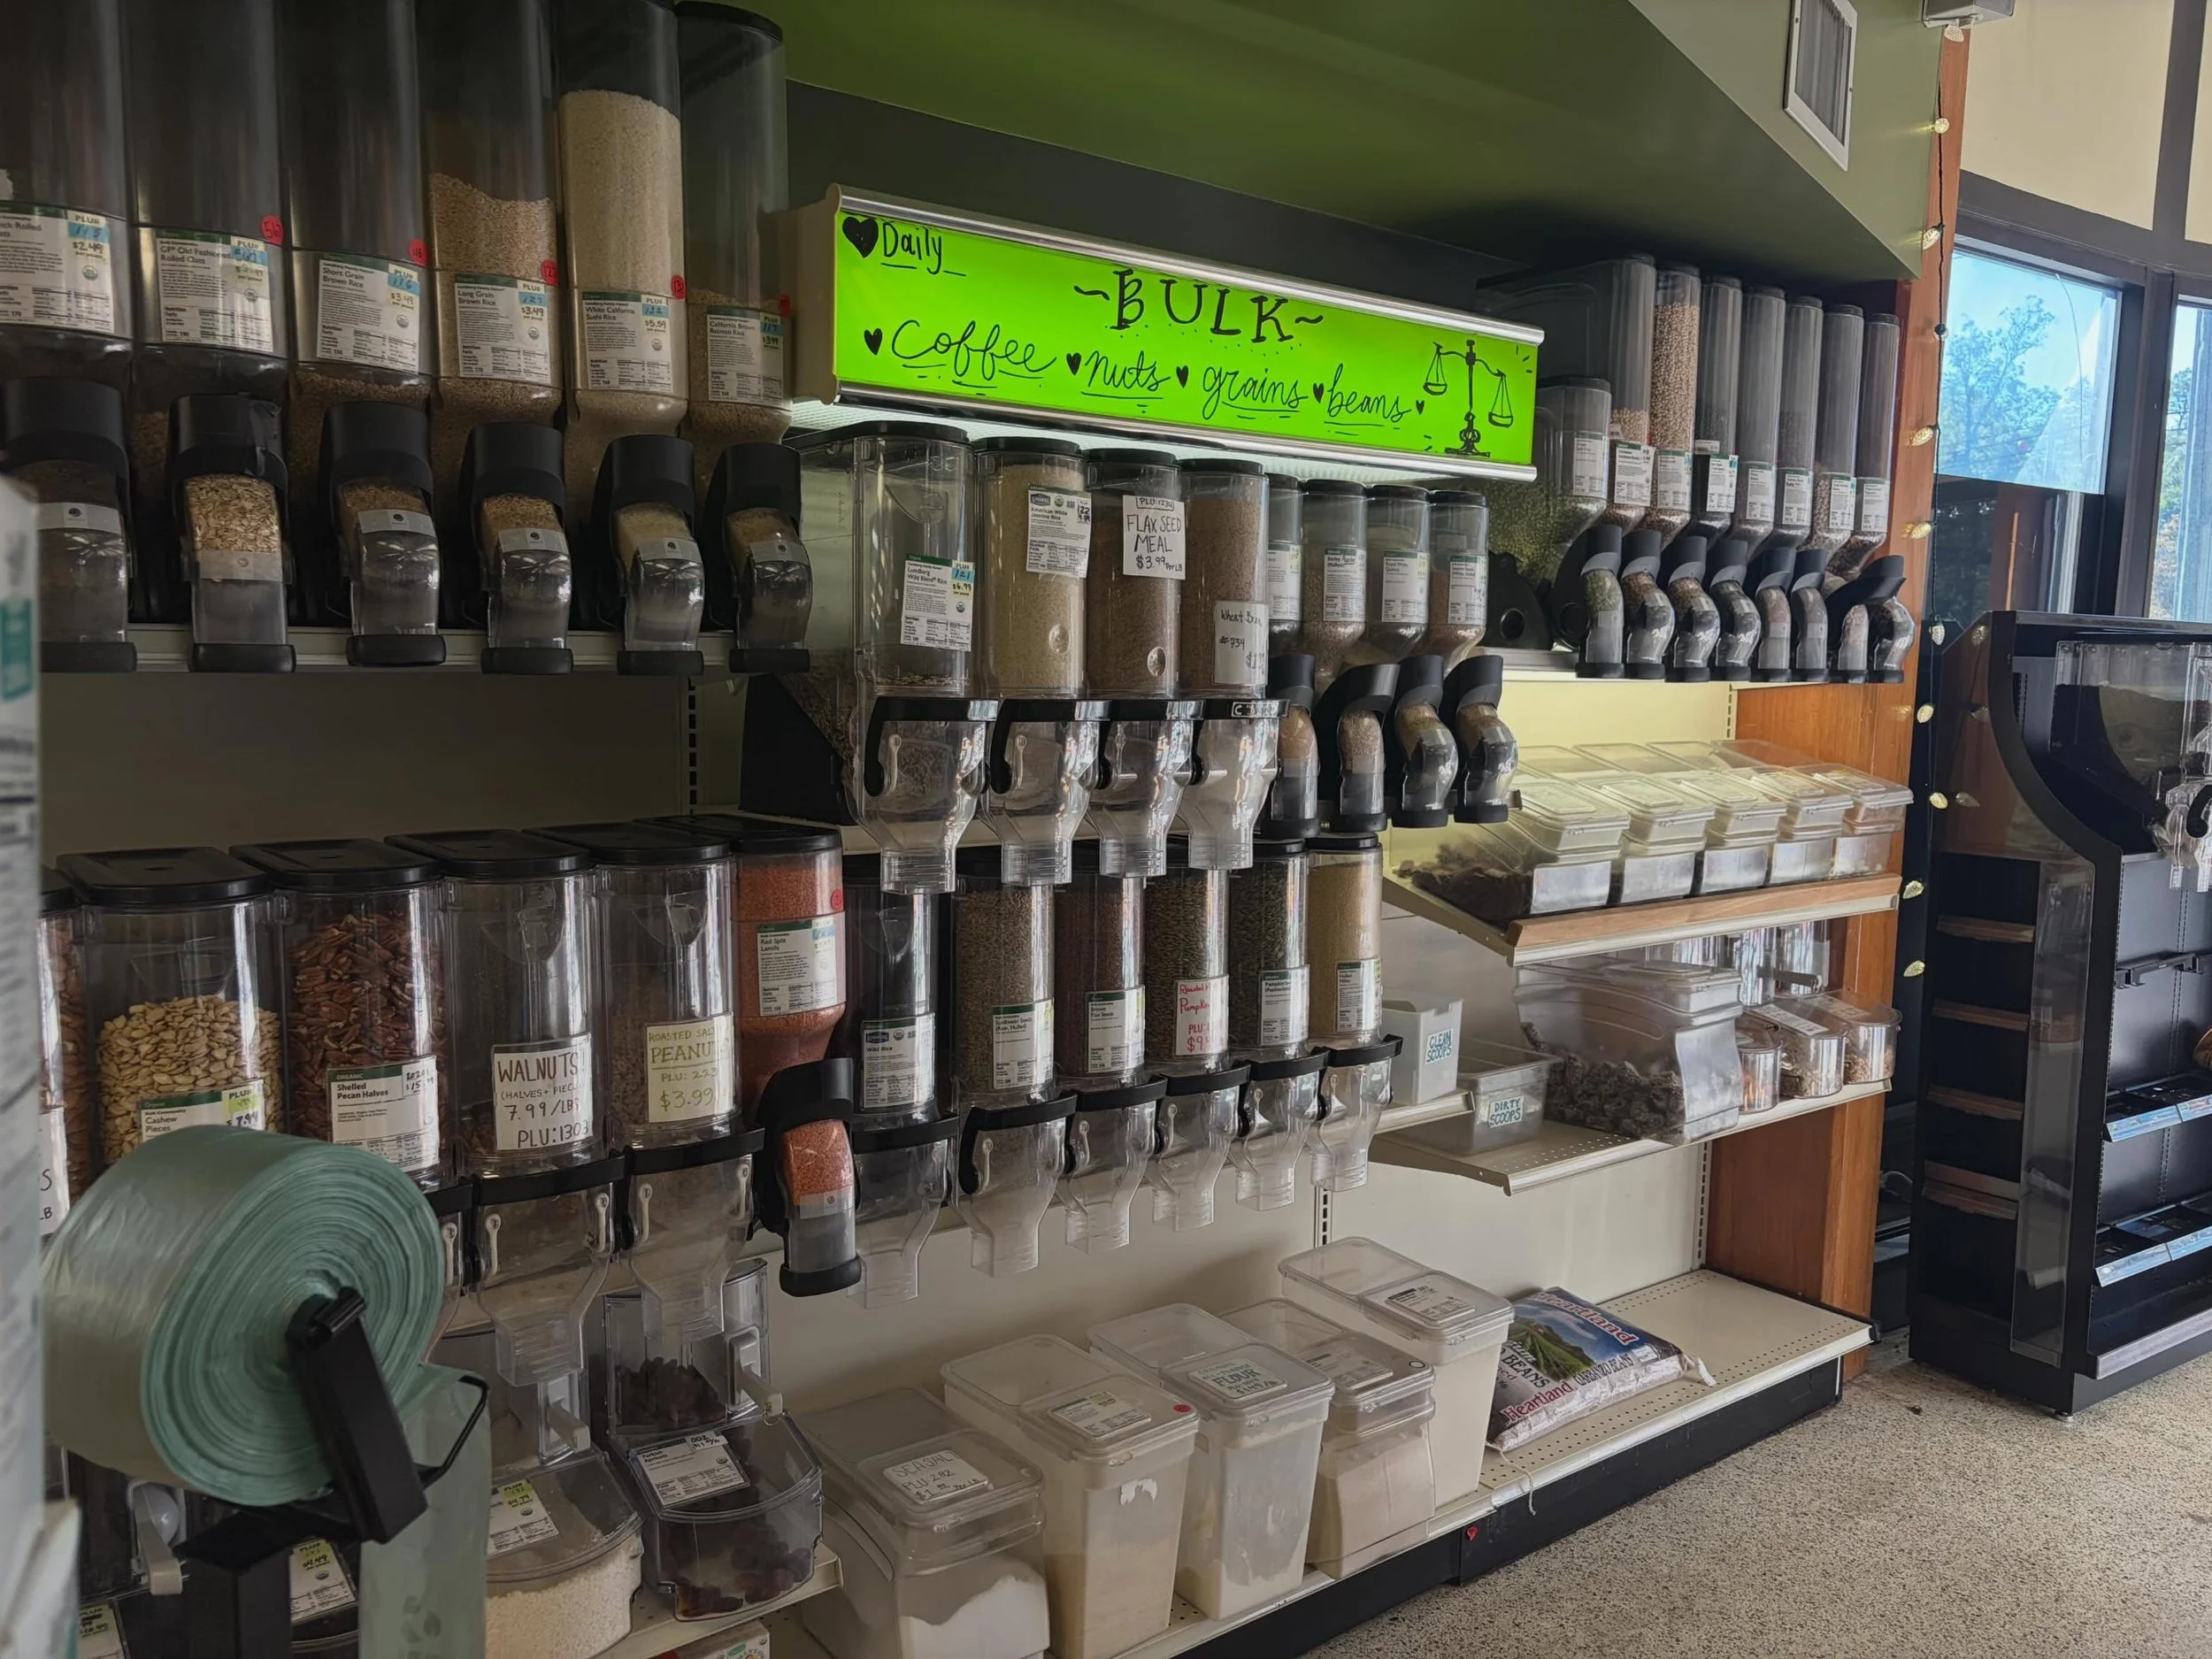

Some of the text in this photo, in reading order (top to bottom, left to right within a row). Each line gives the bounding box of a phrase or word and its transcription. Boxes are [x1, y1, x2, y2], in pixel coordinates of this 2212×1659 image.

[15, 221, 42, 231] Rolled
[177, 246, 192, 255] Old
[194, 248, 231, 258] Fashioned
[882, 221, 943, 275] Daily
[187, 256, 205, 265] Oats
[322, 267, 365, 281] Short Grain
[323, 275, 364, 288] Brown Rice
[477, 290, 495, 299] Grain
[482, 297, 496, 306] Rice
[520, 305, 545, 318] $3.49
[710, 320, 736, 329] California
[892, 319, 1056, 381] Coffee
[1202, 365, 1309, 419] grains
[1326, 363, 1412, 422] beans
[1126, 514, 1182, 534] FLAX SEED
[1133, 534, 1172, 554] MEAL
[907, 567, 930, 576] Lundberg
[1221, 609, 1244, 623] Wheat
[649, 1030, 691, 1042] ROASTED
[1429, 1029, 1452, 1049] CLEAN
[1426, 1045, 1452, 1063] SCOOPS
[336, 1082, 367, 1092] Shelled
[362, 1089, 389, 1098] Halves
[501, 1088, 542, 1101] (HALVES
[660, 1087, 714, 1112] $3.99
[1494, 1098, 1521, 1112] DIRTY
[1490, 1108, 1521, 1126] SCOOPS
[1607, 1353, 1634, 1373] BEANS
[1502, 1354, 1550, 1388] BEANS
[1502, 1380, 1575, 1423] Heartland
[642, 1450, 664, 1459] Turkish
[644, 1454, 668, 1463] Apricots
